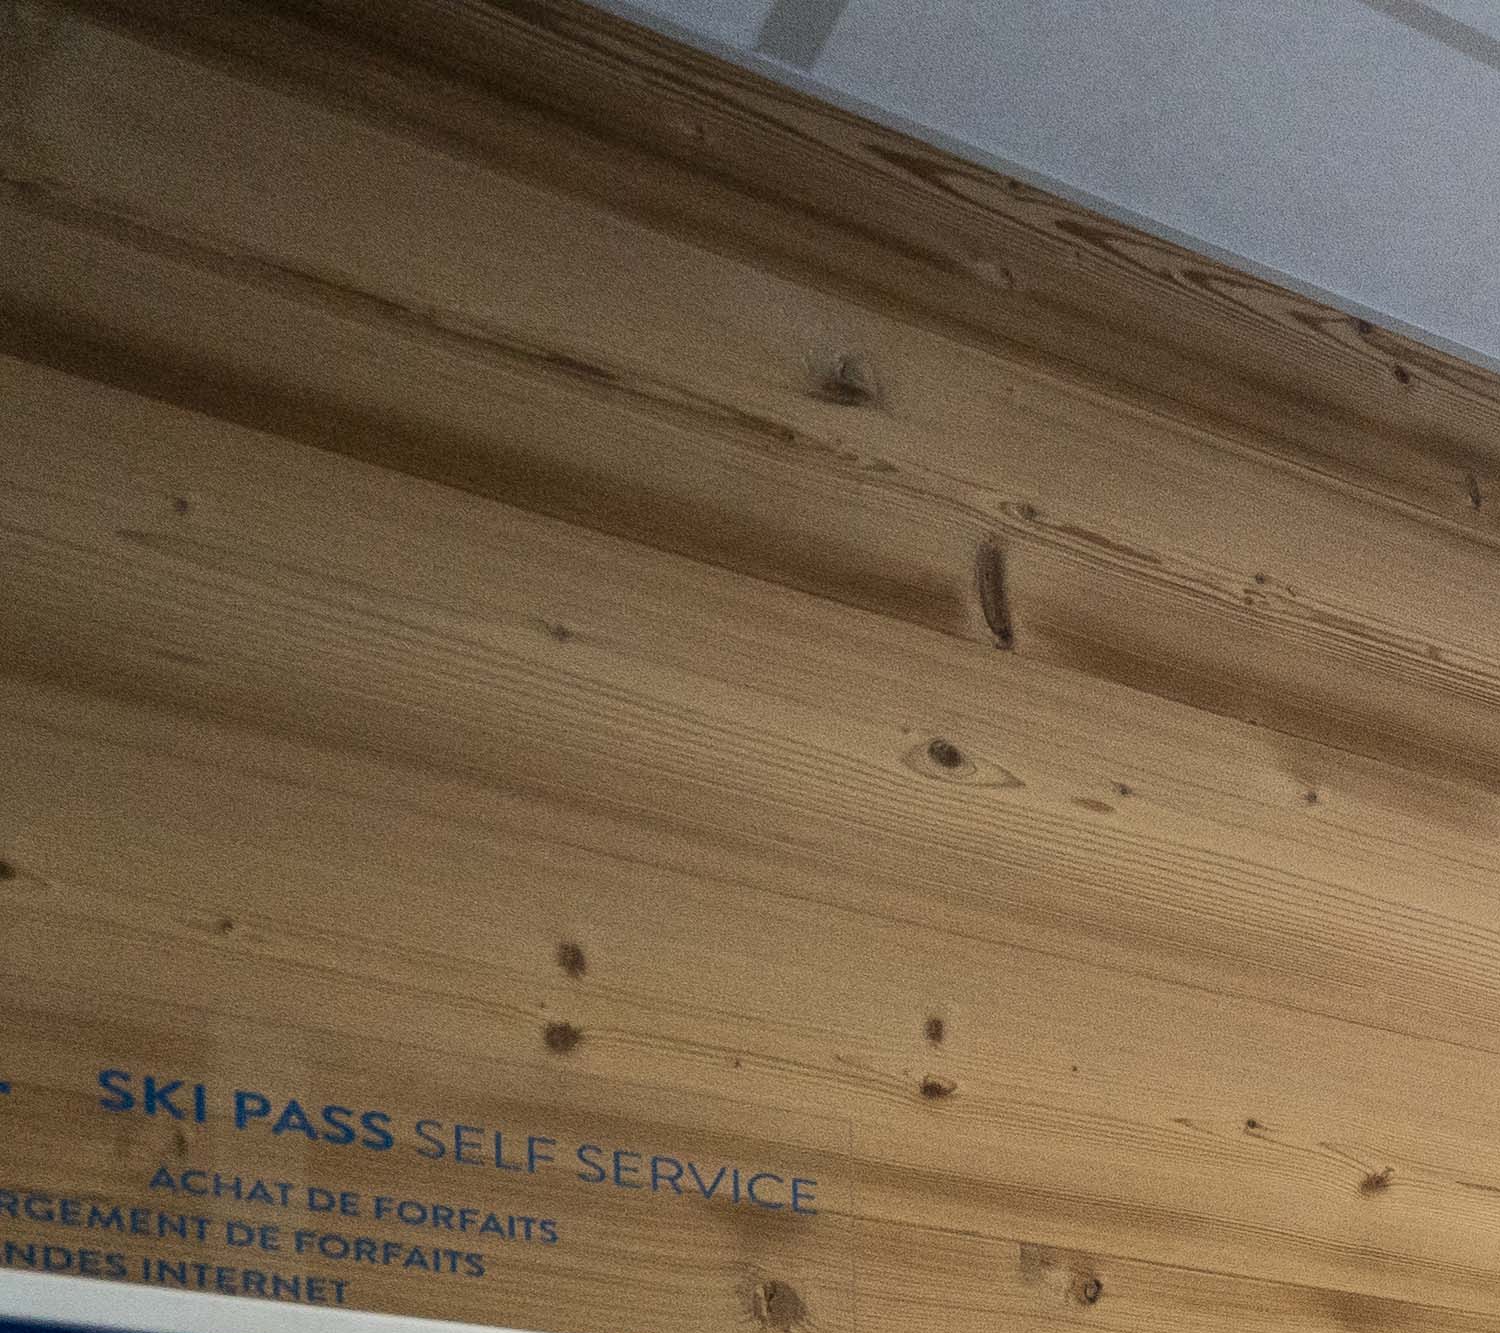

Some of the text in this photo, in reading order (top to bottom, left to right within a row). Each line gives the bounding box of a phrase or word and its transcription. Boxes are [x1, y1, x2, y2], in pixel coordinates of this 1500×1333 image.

[99, 1068, 818, 1215] SKI PASS SELF SERVICE
[149, 1165, 559, 1244] ACHAT DE FORFAITS
[143, 1257, 349, 1305] INTERNET
[226, 1219, 281, 1251] DE
[294, 1229, 486, 1278] FORFAITS
